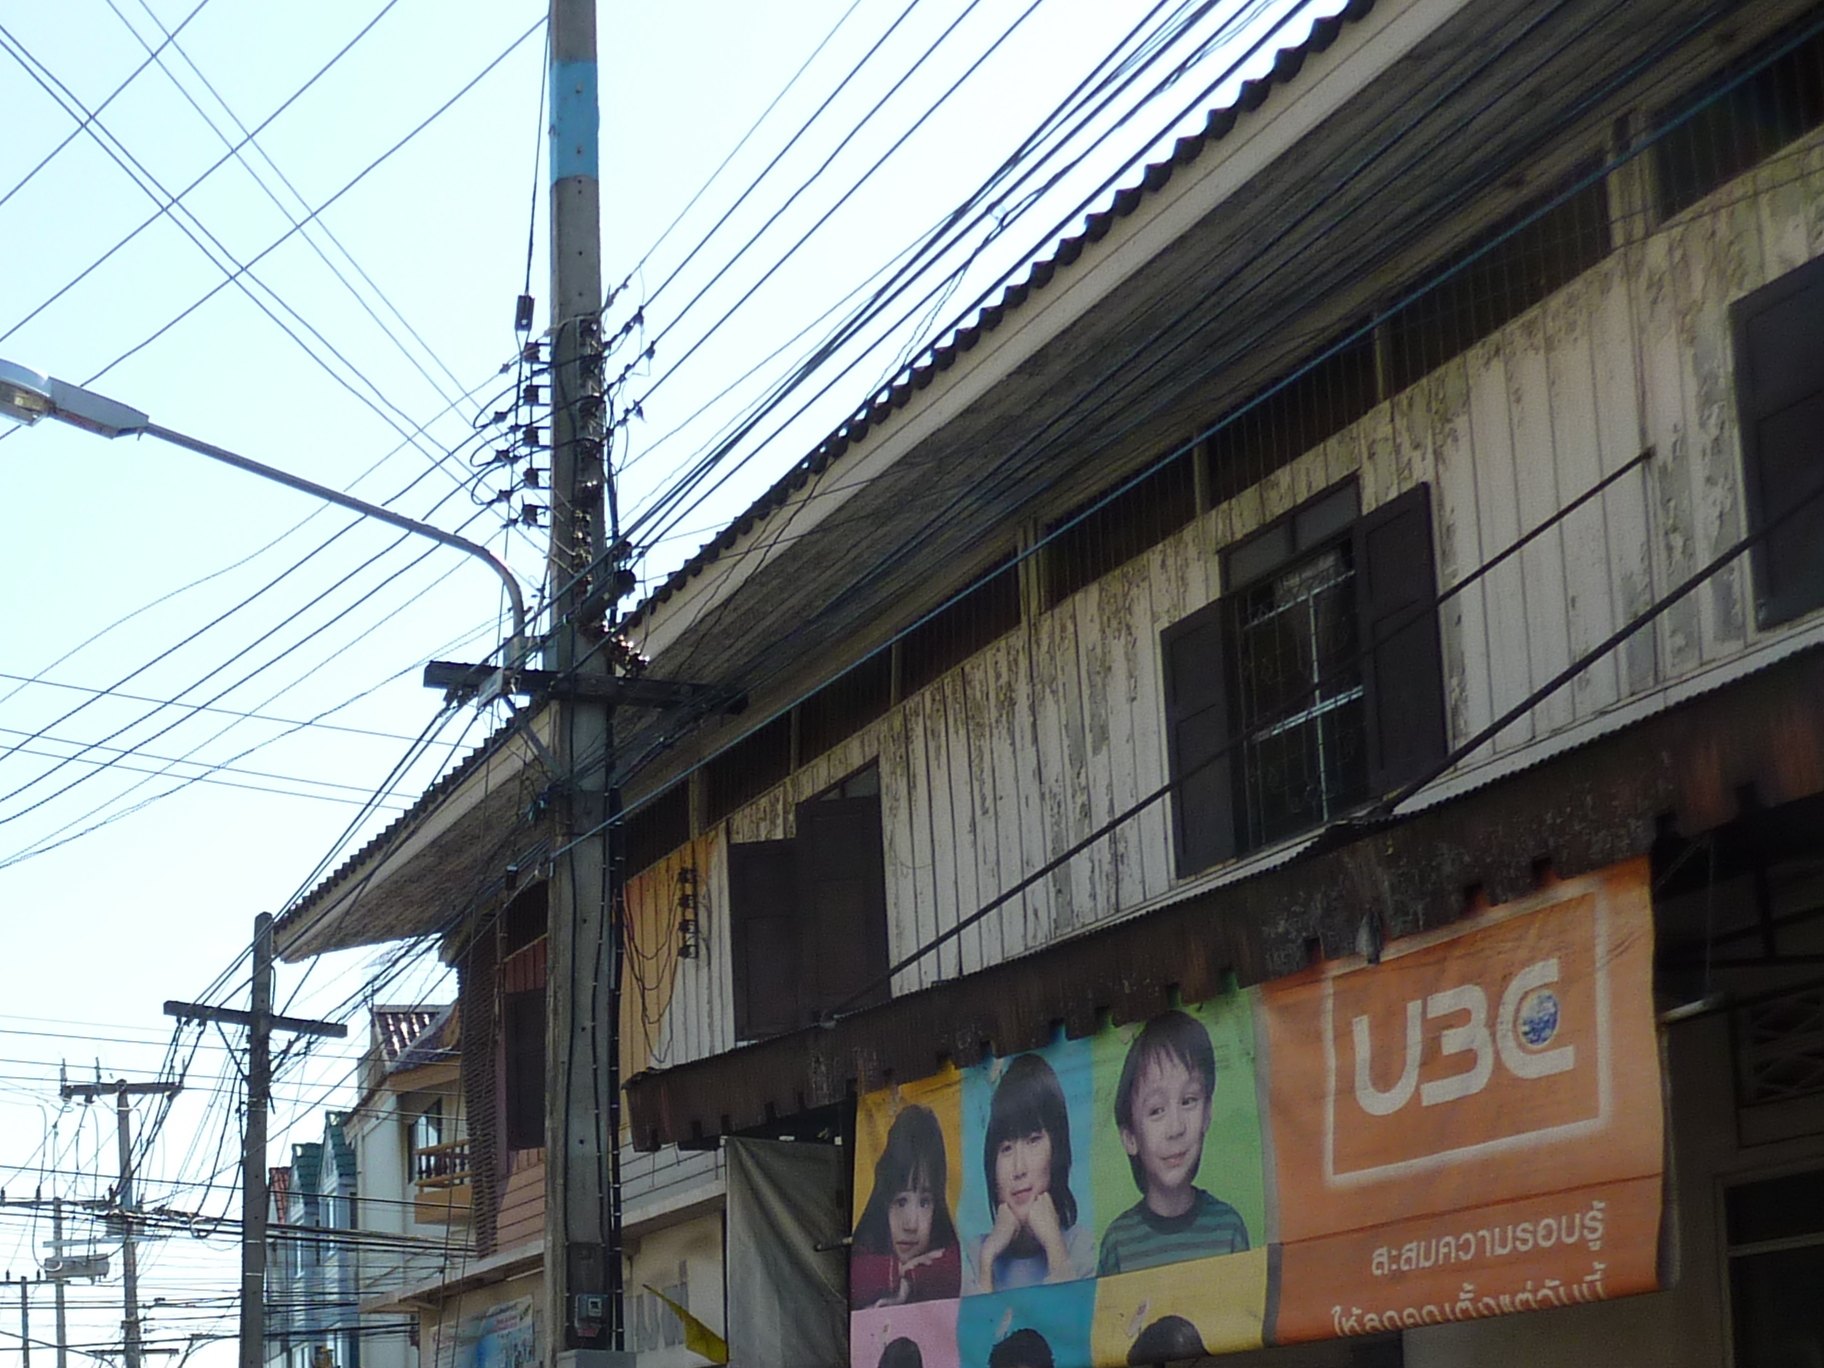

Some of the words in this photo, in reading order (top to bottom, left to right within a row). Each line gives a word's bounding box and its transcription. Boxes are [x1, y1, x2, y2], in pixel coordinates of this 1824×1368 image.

[1371, 1200, 1607, 1277] สะสมความรอบรู้
